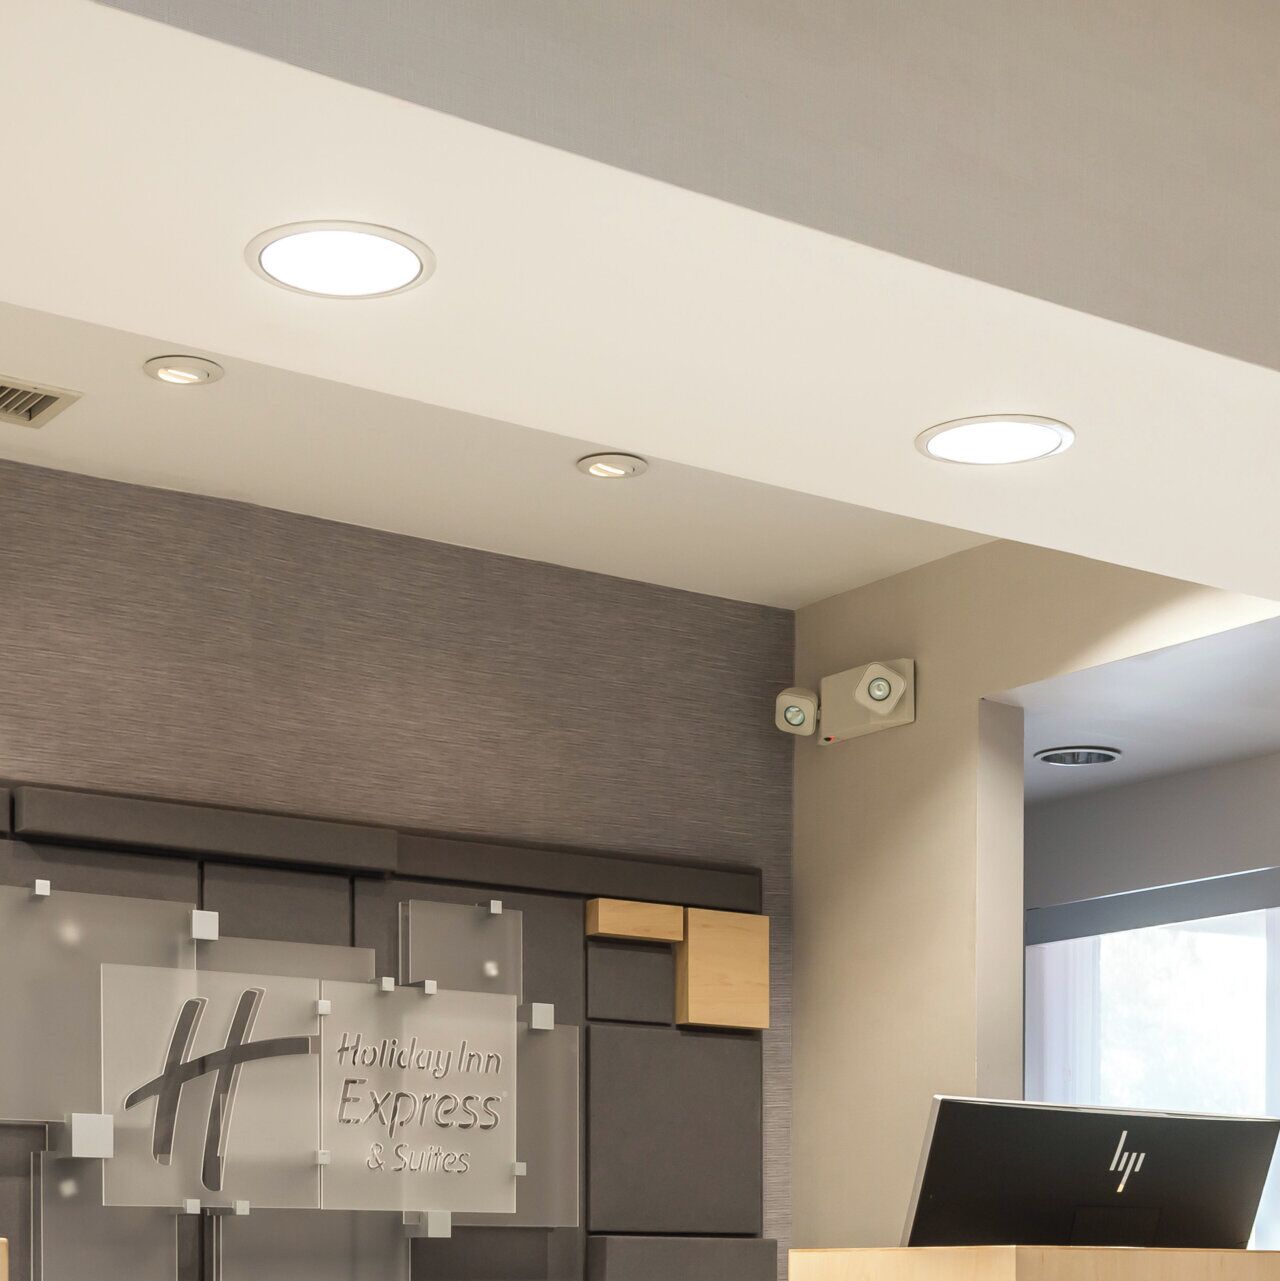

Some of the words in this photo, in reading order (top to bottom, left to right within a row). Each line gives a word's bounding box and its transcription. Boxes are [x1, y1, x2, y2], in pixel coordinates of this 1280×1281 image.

[336, 1031, 453, 1079] Holiday
[457, 1039, 503, 1075] Inn
[336, 1077, 503, 1138] Express
[366, 1142, 386, 1171] &
[392, 1142, 471, 1174] Suites
